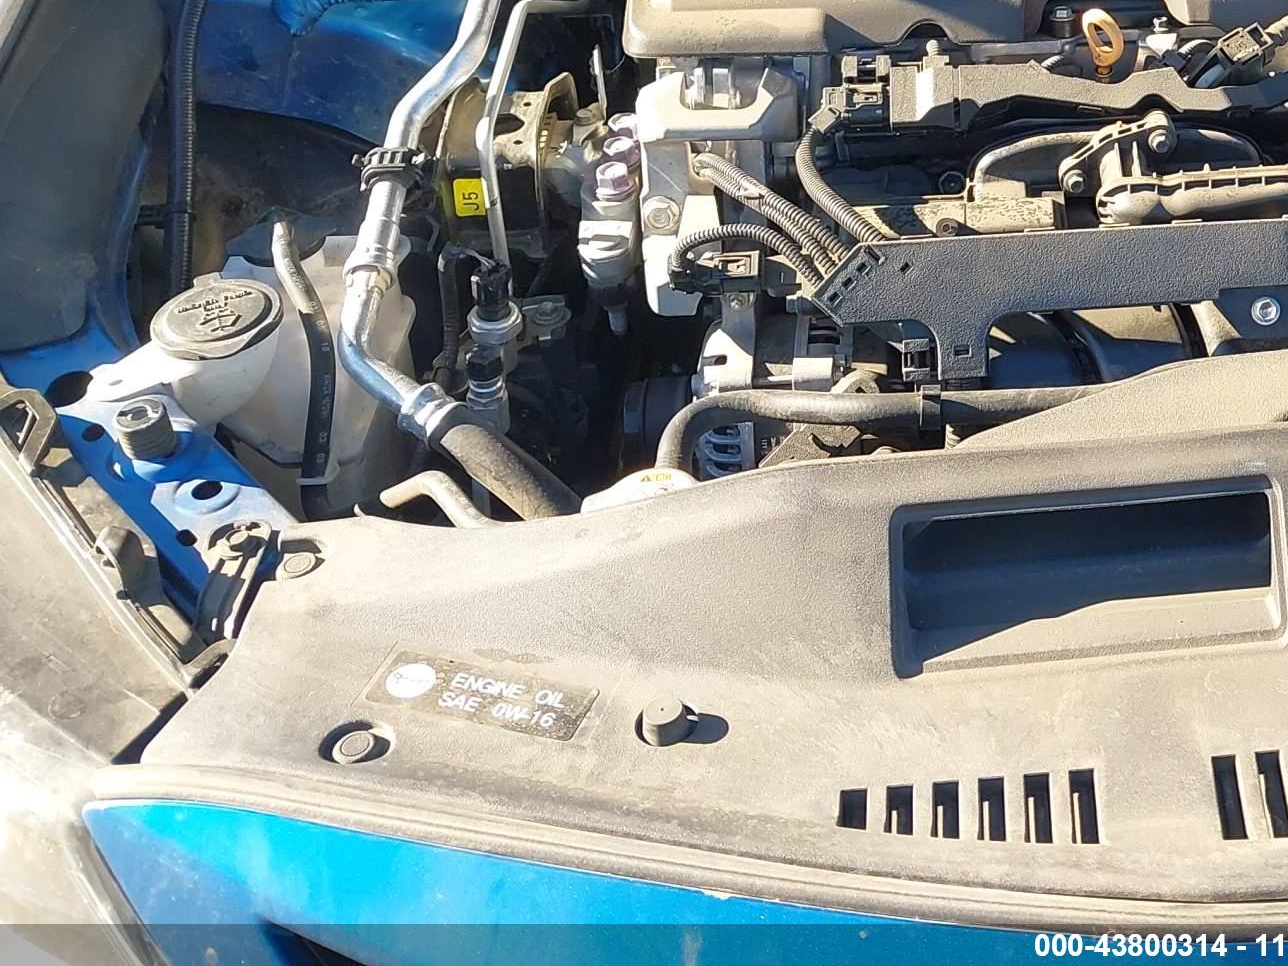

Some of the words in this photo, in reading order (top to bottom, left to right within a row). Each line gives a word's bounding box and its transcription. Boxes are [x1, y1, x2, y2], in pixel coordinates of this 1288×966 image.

[462, 192, 479, 211] J5
[451, 672, 528, 699] ENGINE
[536, 689, 566, 709] OIL
[438, 692, 481, 712] SAE
[491, 703, 556, 727] 0W-16
